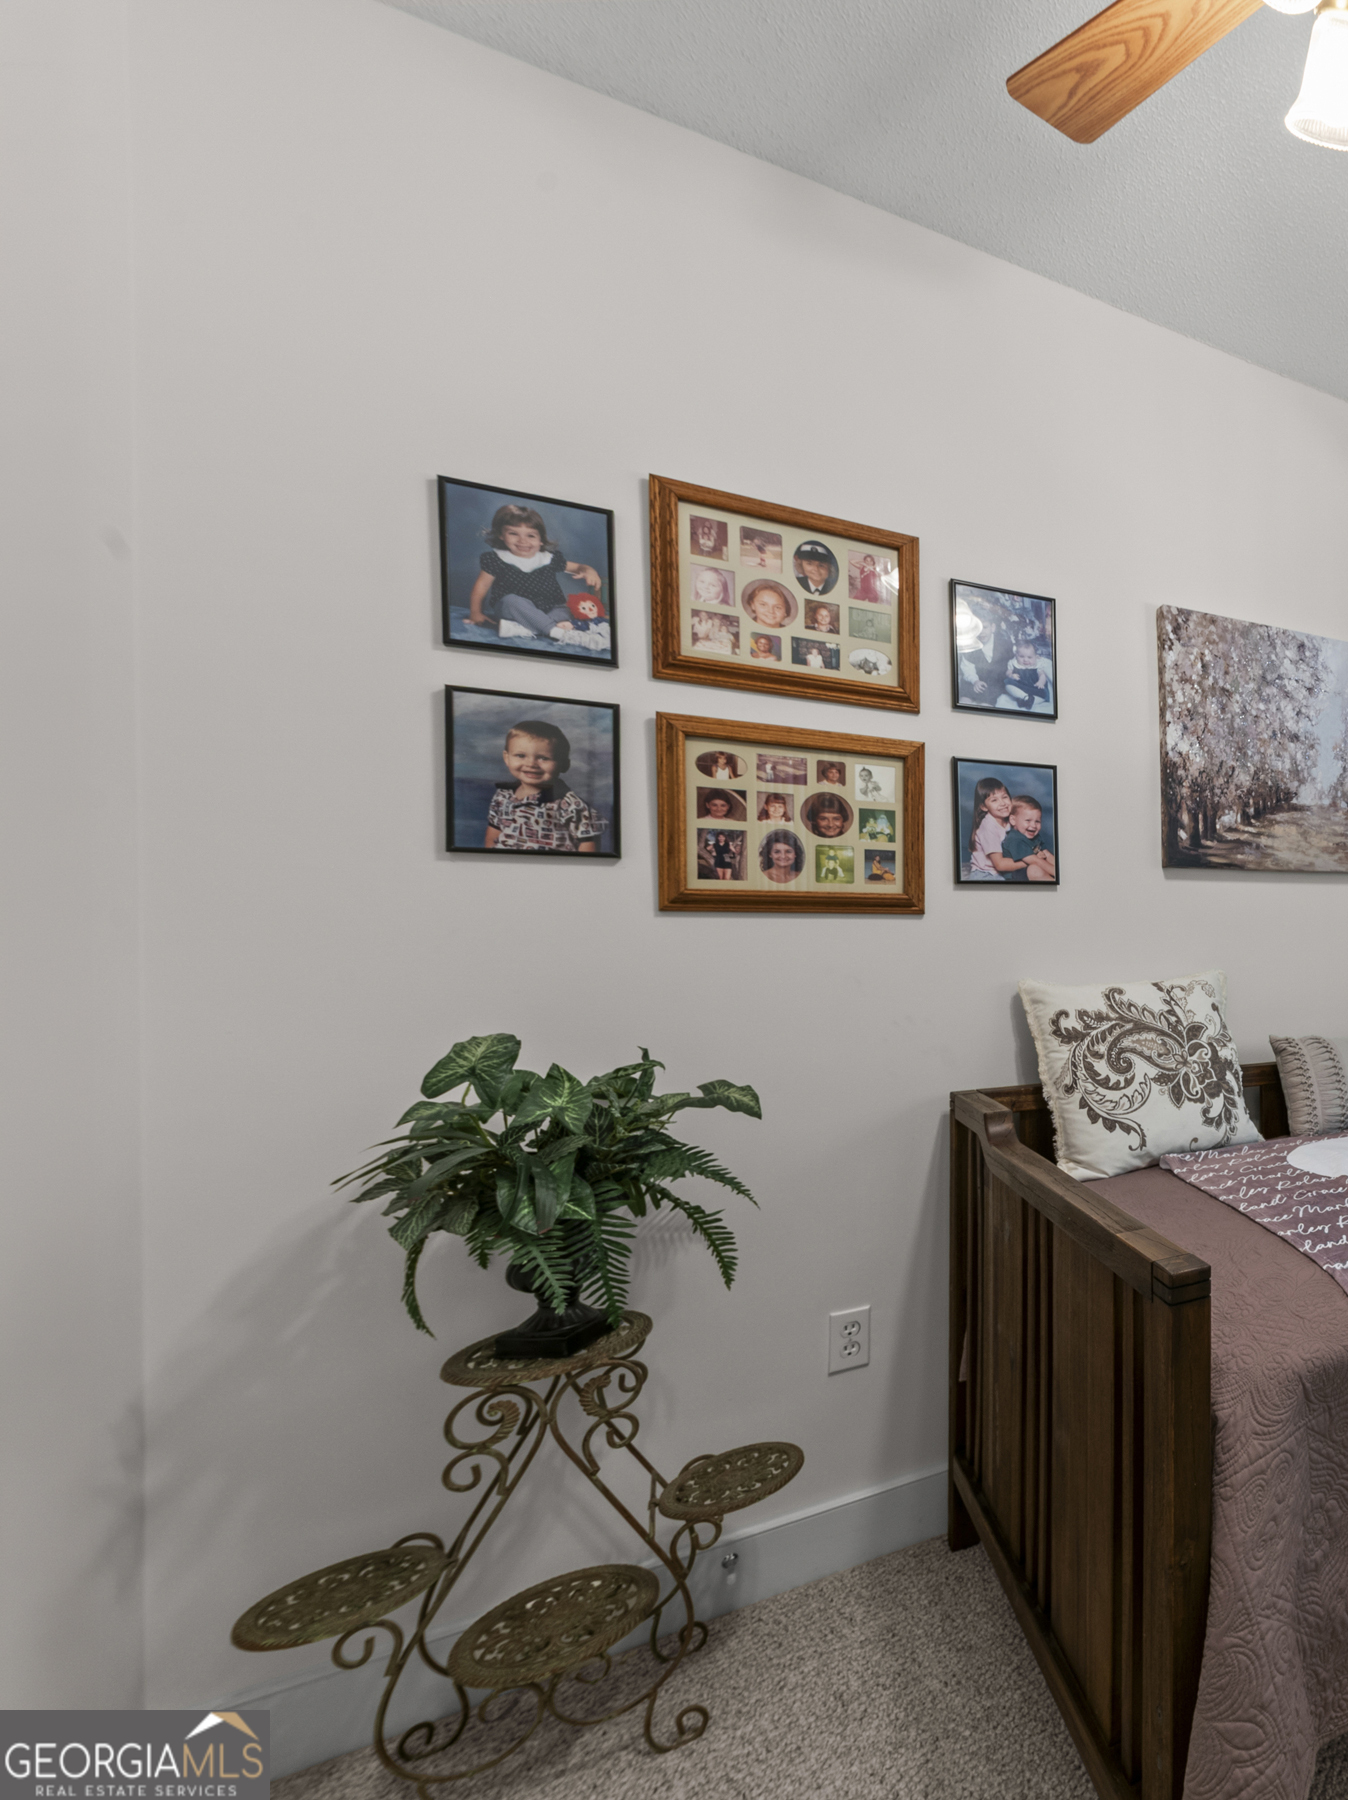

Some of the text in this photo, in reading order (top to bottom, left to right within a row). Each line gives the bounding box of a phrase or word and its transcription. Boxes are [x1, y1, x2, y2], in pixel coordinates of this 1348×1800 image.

[1195, 1146, 1265, 1162] Marley
[1228, 1151, 1288, 1166] Roland
[1293, 1187, 1347, 1199] Grace
